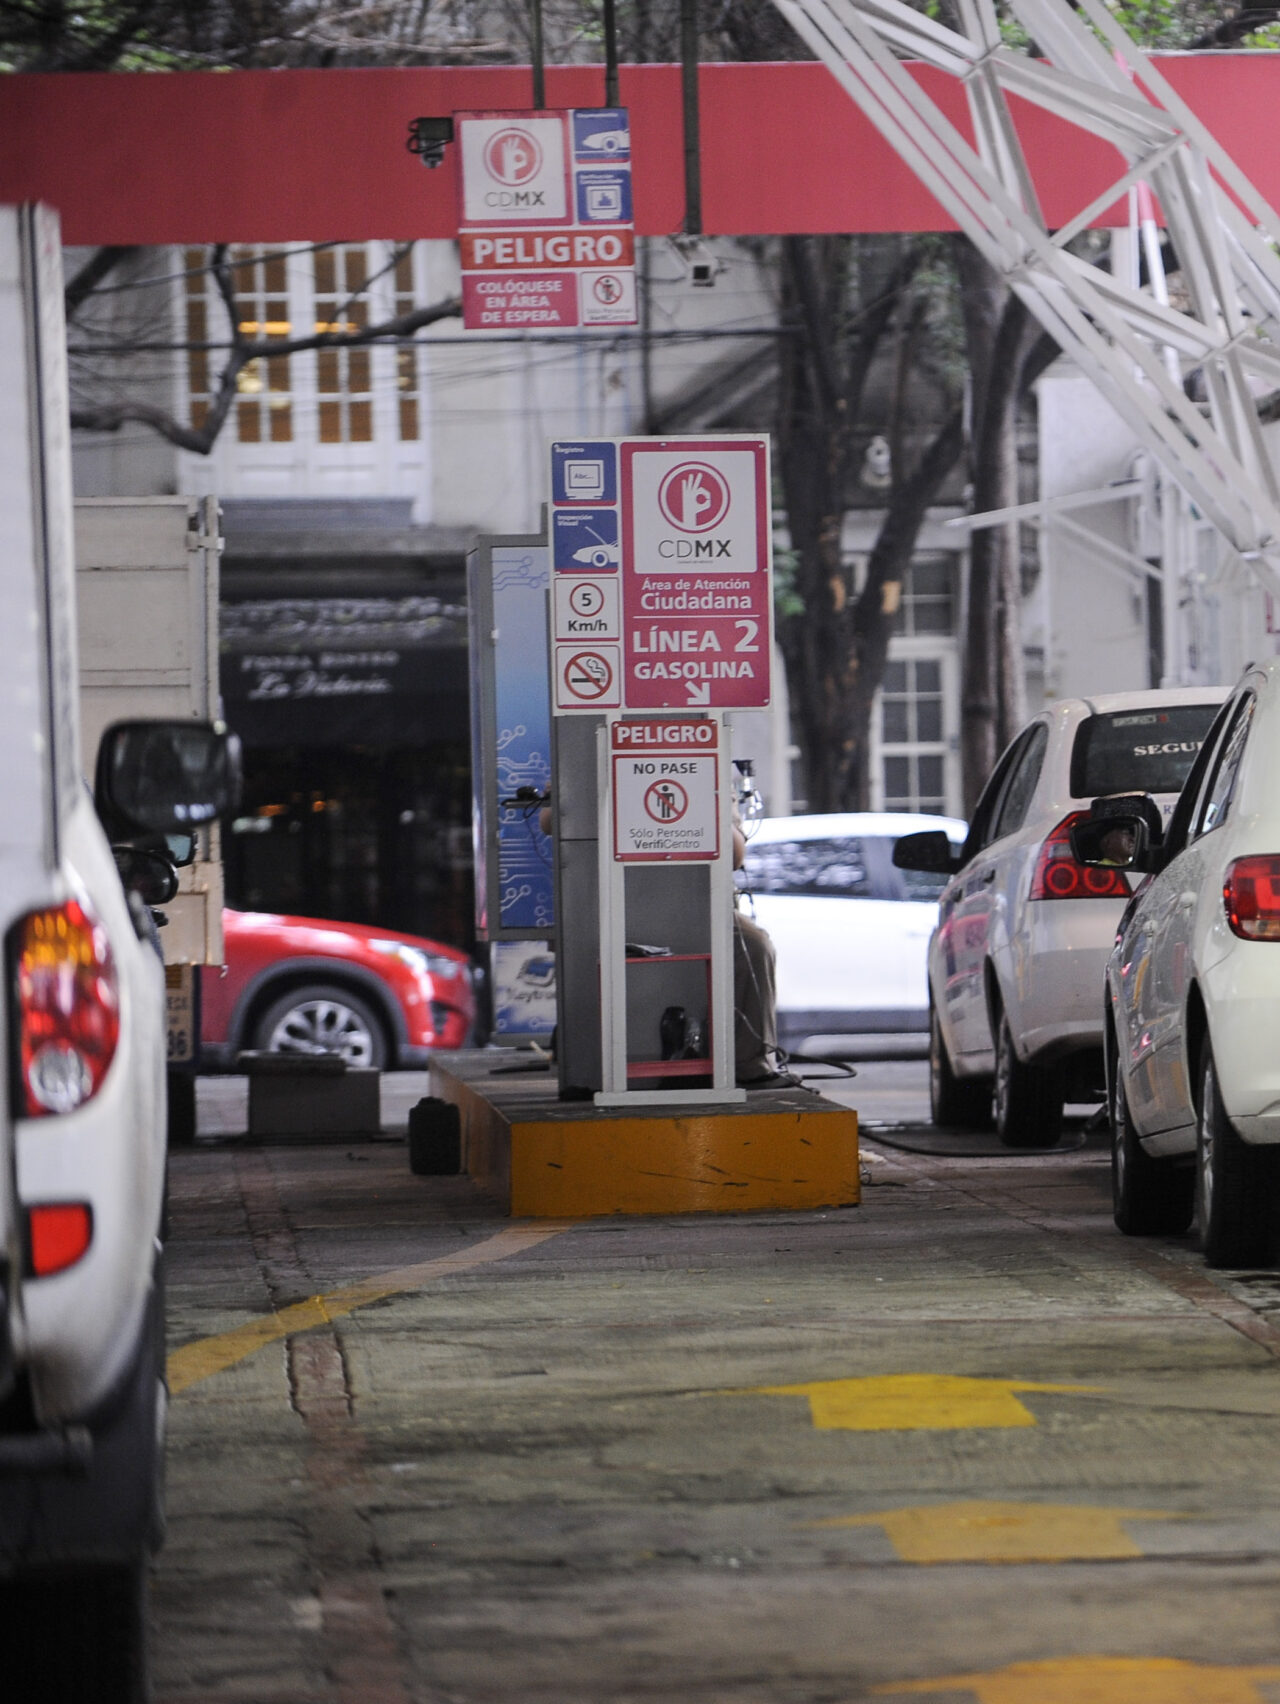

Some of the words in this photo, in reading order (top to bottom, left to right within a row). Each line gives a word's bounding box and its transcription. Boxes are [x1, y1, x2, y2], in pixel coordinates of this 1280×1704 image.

[484, 191, 545, 208] CDMX
[473, 235, 622, 265] PELIGRO
[476, 279, 563, 294] COLÓQUESE
[485, 297, 507, 308] EN
[509, 294, 550, 307] ÁREA
[481, 311, 502, 323] DE
[505, 310, 560, 322] ESPERA
[658, 539, 732, 558] CDMX
[641, 577, 672, 590] Área
[674, 579, 691, 590] de
[693, 578, 750, 590] Atención
[581, 593, 592, 607] 5
[640, 591, 752, 610] Ciudadana
[567, 620, 608, 632] Km/h
[633, 626, 721, 653] LÍNEA
[734, 619, 759, 652] 2
[633, 661, 755, 679] GASOLINA
[616, 725, 713, 743] PELIGRO
[633, 763, 655, 774] NO
[660, 762, 698, 774] PASE
[629, 827, 654, 838] Sólo
[657, 827, 704, 838] Personal
[634, 839, 700, 849] VerifiCentro
